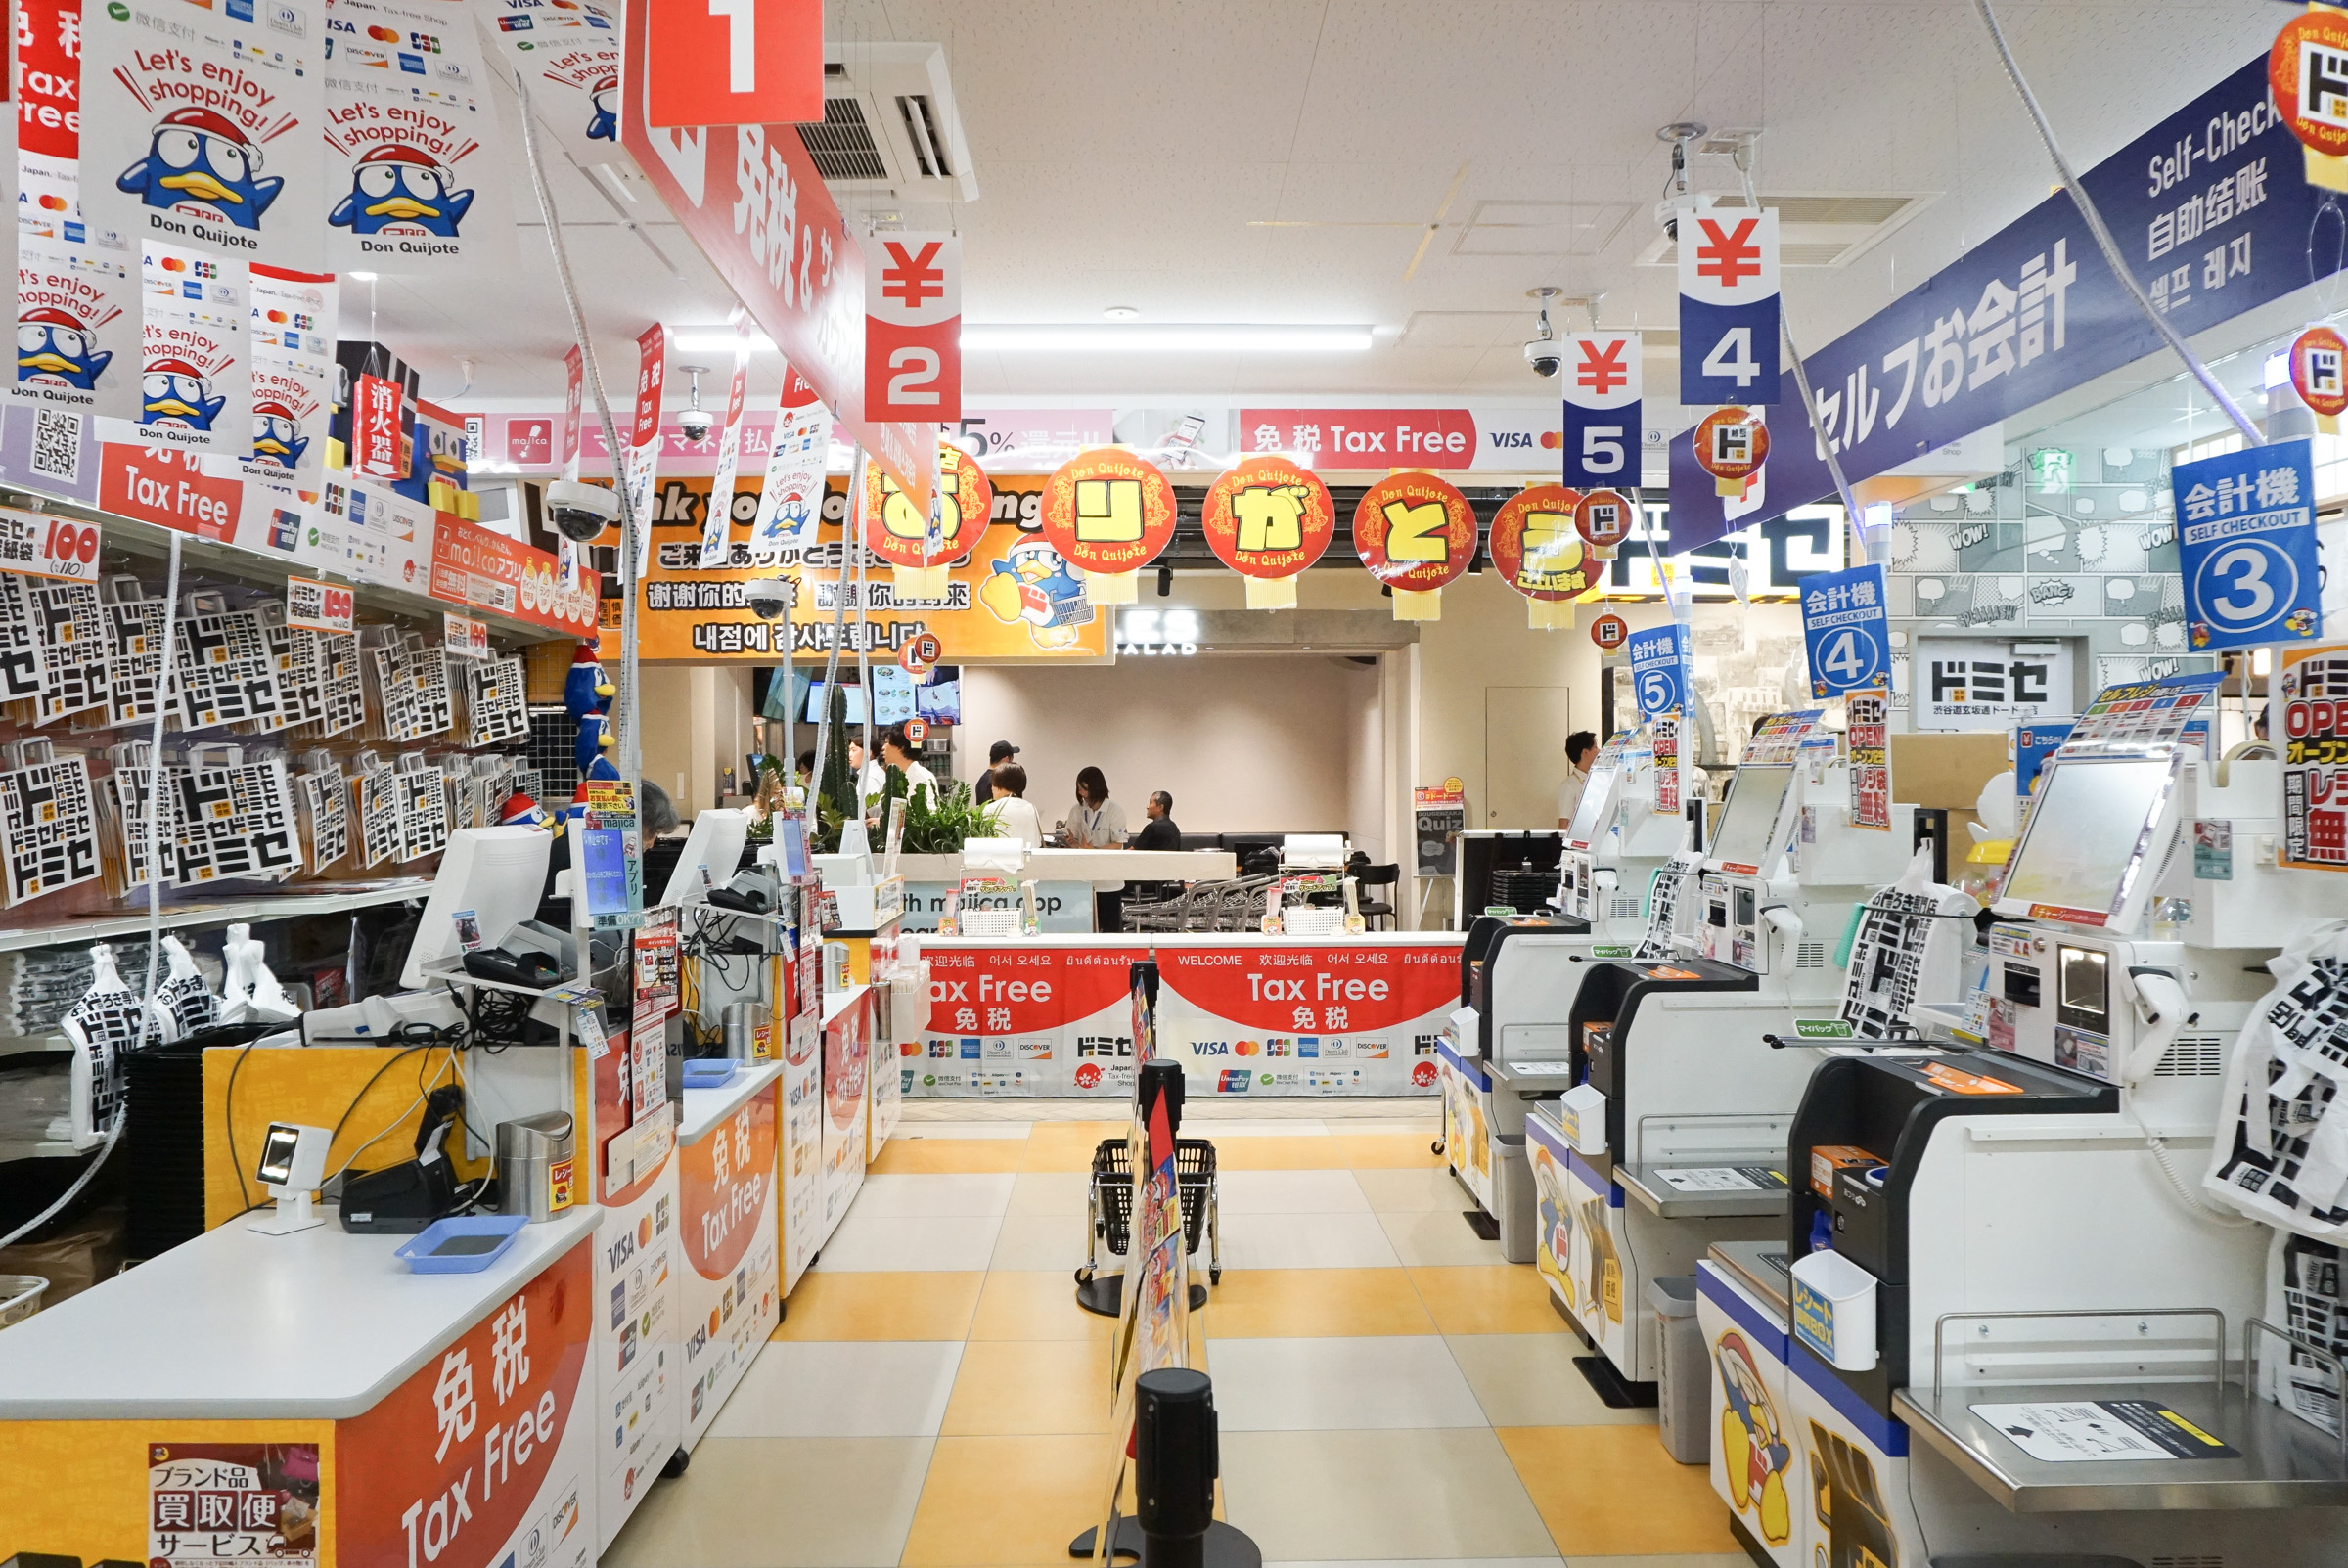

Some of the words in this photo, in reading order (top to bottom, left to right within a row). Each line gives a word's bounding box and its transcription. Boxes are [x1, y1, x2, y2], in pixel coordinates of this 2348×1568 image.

[424, 15, 447, 26] Shop
[347, 47, 384, 59] DISCOVER
[549, 52, 592, 69] Let's
[708, 0, 754, 93] 1
[135, 48, 192, 73] Let's
[202, 62, 276, 107] enjoy
[149, 78, 268, 131] shopping!
[327, 102, 380, 124] Let's
[387, 106, 456, 136] enjoy
[344, 126, 453, 155] shopping!
[2147, 157, 2267, 262] 自助结账
[150, 214, 186, 234] Don
[193, 225, 257, 249] Quijote
[361, 241, 393, 253] Don
[398, 242, 459, 257] Quijote
[1697, 218, 1760, 287] ¥
[2204, 232, 2251, 291] 레지
[46, 273, 105, 303] enjoy
[883, 243, 943, 308] ¥
[168, 328, 218, 352] enjoy
[1809, 238, 2077, 462] セルフお会計
[1577, 340, 1627, 394] ¥
[1702, 328, 1760, 387] 4
[270, 375, 309, 398] enjoy
[888, 347, 940, 405] 2
[43, 389, 94, 405] Quijote
[140, 428, 162, 439] Don
[167, 431, 210, 444] Quijote
[369, 383, 393, 463] 消火器
[638, 416, 653, 433] Free
[1331, 426, 1386, 452] Tax
[1396, 426, 1466, 453] Free
[1489, 432, 1533, 448] VISA
[1582, 426, 1624, 474] 5
[243, 466, 260, 476] Don
[263, 469, 294, 480] Quijote
[1071, 465, 1094, 480] Don
[1099, 463, 1143, 481] Quijote
[1231, 474, 1253, 487] Don
[1258, 470, 1302, 486] Quijote
[125, 465, 170, 511] Tax
[177, 481, 228, 525] Free
[325, 484, 344, 515] JCB
[1381, 489, 1403, 501] Don
[1407, 486, 1448, 503] Quijote
[1518, 501, 1539, 514] Don
[2183, 467, 2299, 522] 会計機
[392, 513, 414, 527] DISCOVER
[1075, 479, 1144, 542] り
[1231, 484, 1309, 552] が
[1381, 499, 1449, 563] と
[1949, 524, 1989, 550] WOW!
[2190, 525, 2218, 541] SELF
[2223, 512, 2301, 536] CHECKOUT
[44, 520, 98, 563] 100
[1074, 544, 1096, 559] Don
[1102, 545, 1147, 562] Quijote
[1521, 511, 1585, 574] う
[1235, 551, 1257, 563] Don
[1261, 551, 1305, 568] Quijote
[1408, 564, 1449, 581] Quijote
[1806, 581, 1877, 614] 会計機
[2030, 586, 2074, 603] BANG!
[2213, 549, 2275, 621] 3
[1811, 617, 1829, 628] SELF
[1830, 610, 1878, 626] CHECKOUT
[696, 624, 766, 650] 내점에
[1632, 637, 1673, 660] 会計機
[1636, 662, 1648, 671] SELF
[1650, 658, 1675, 668] CHECKOUT
[1825, 632, 1864, 679] 4
[2139, 657, 2180, 682] WOW!
[1644, 674, 1665, 710] 5
[1932, 661, 2047, 702] ドミセ
[1851, 698, 1885, 723] ドミセ
[1849, 724, 1885, 747] OPEN!
[1417, 817, 1463, 831] Quiz
[627, 860, 638, 896] アプリ
[989, 955, 1012, 967] 어서
[1017, 955, 1051, 967] 오세요
[1177, 955, 1242, 965] WELCOME
[1259, 953, 1313, 967] 欢迎光临
[1327, 953, 1349, 965] 어서
[1355, 953, 1389, 965] 오세요
[929, 980, 968, 1002] ax
[979, 974, 1052, 1002] Free
[1247, 973, 1306, 1002] Tax
[1317, 973, 1389, 1002] Free
[929, 1041, 953, 1057] JCB
[1189, 1042, 1228, 1055] VISA
[1267, 1040, 1290, 1056] JCB
[1221, 1075, 1250, 1085] UnionPay
[701, 1209, 727, 1260] Tax
[731, 1177, 761, 1230] Free
[607, 1231, 634, 1273] VISA
[686, 1323, 706, 1364] VISA
[155, 1466, 248, 1489] ブランド品
[401, 1467, 473, 1568] Tax
[484, 1390, 556, 1502] Free
[157, 1493, 276, 1528] 買取便
[553, 1491, 578, 1530] DISCOVER
[157, 1534, 260, 1557] サービス
